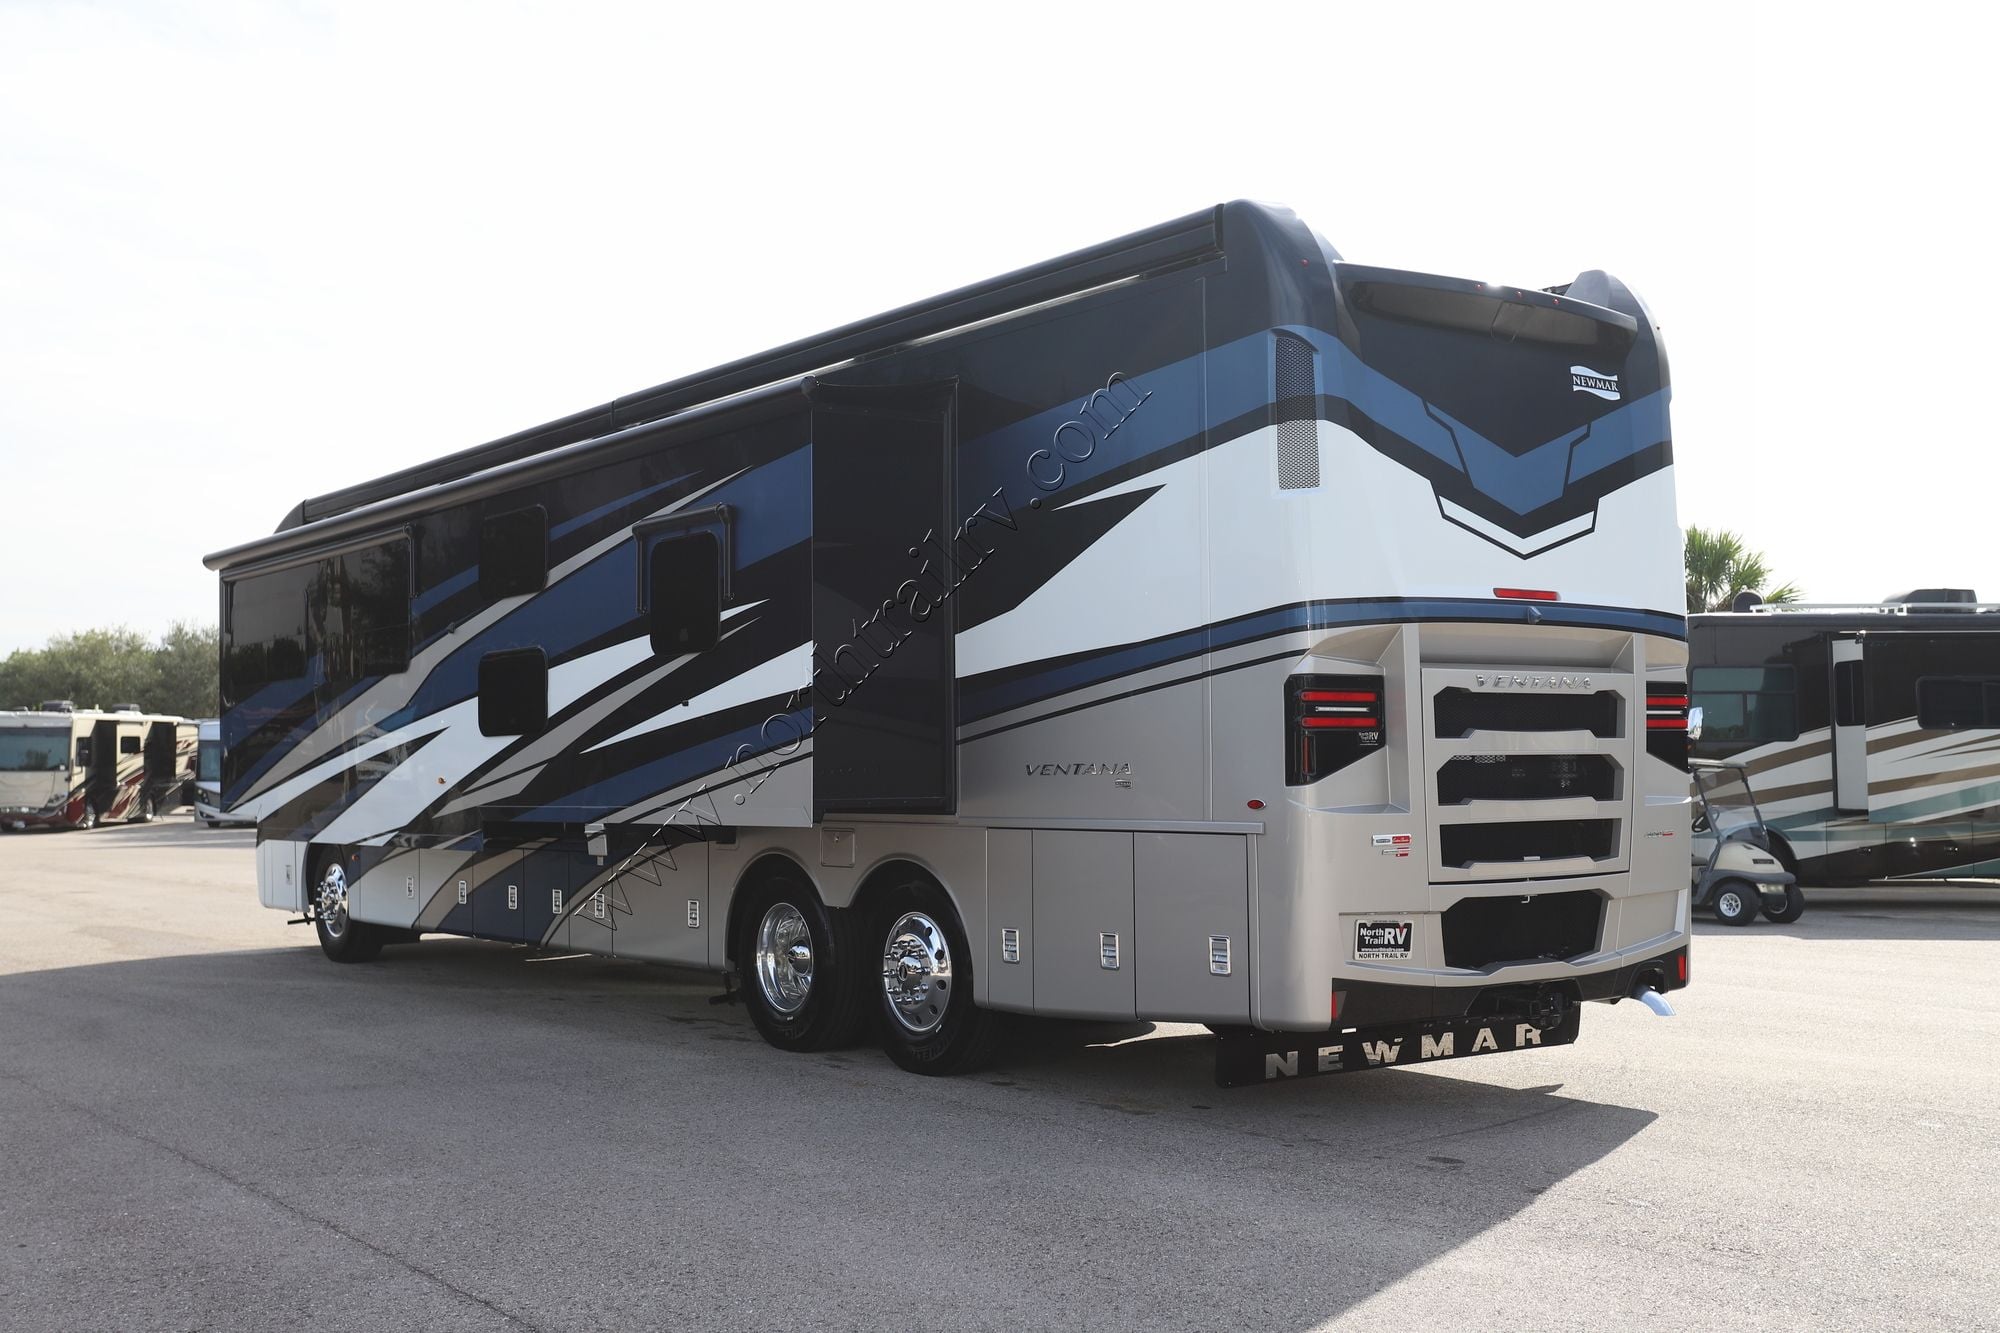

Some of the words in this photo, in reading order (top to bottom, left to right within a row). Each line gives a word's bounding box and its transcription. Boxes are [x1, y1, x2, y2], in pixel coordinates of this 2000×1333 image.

[1572, 375, 1619, 392] NEWMAR
[1475, 674, 1592, 689] VENTANA
[1025, 763, 1132, 776] VENTANA
[1360, 927, 1384, 936] North
[1364, 936, 1384, 945] Trail
[1384, 927, 1408, 945] RV
[1264, 1022, 1542, 1080] NEWMAR
